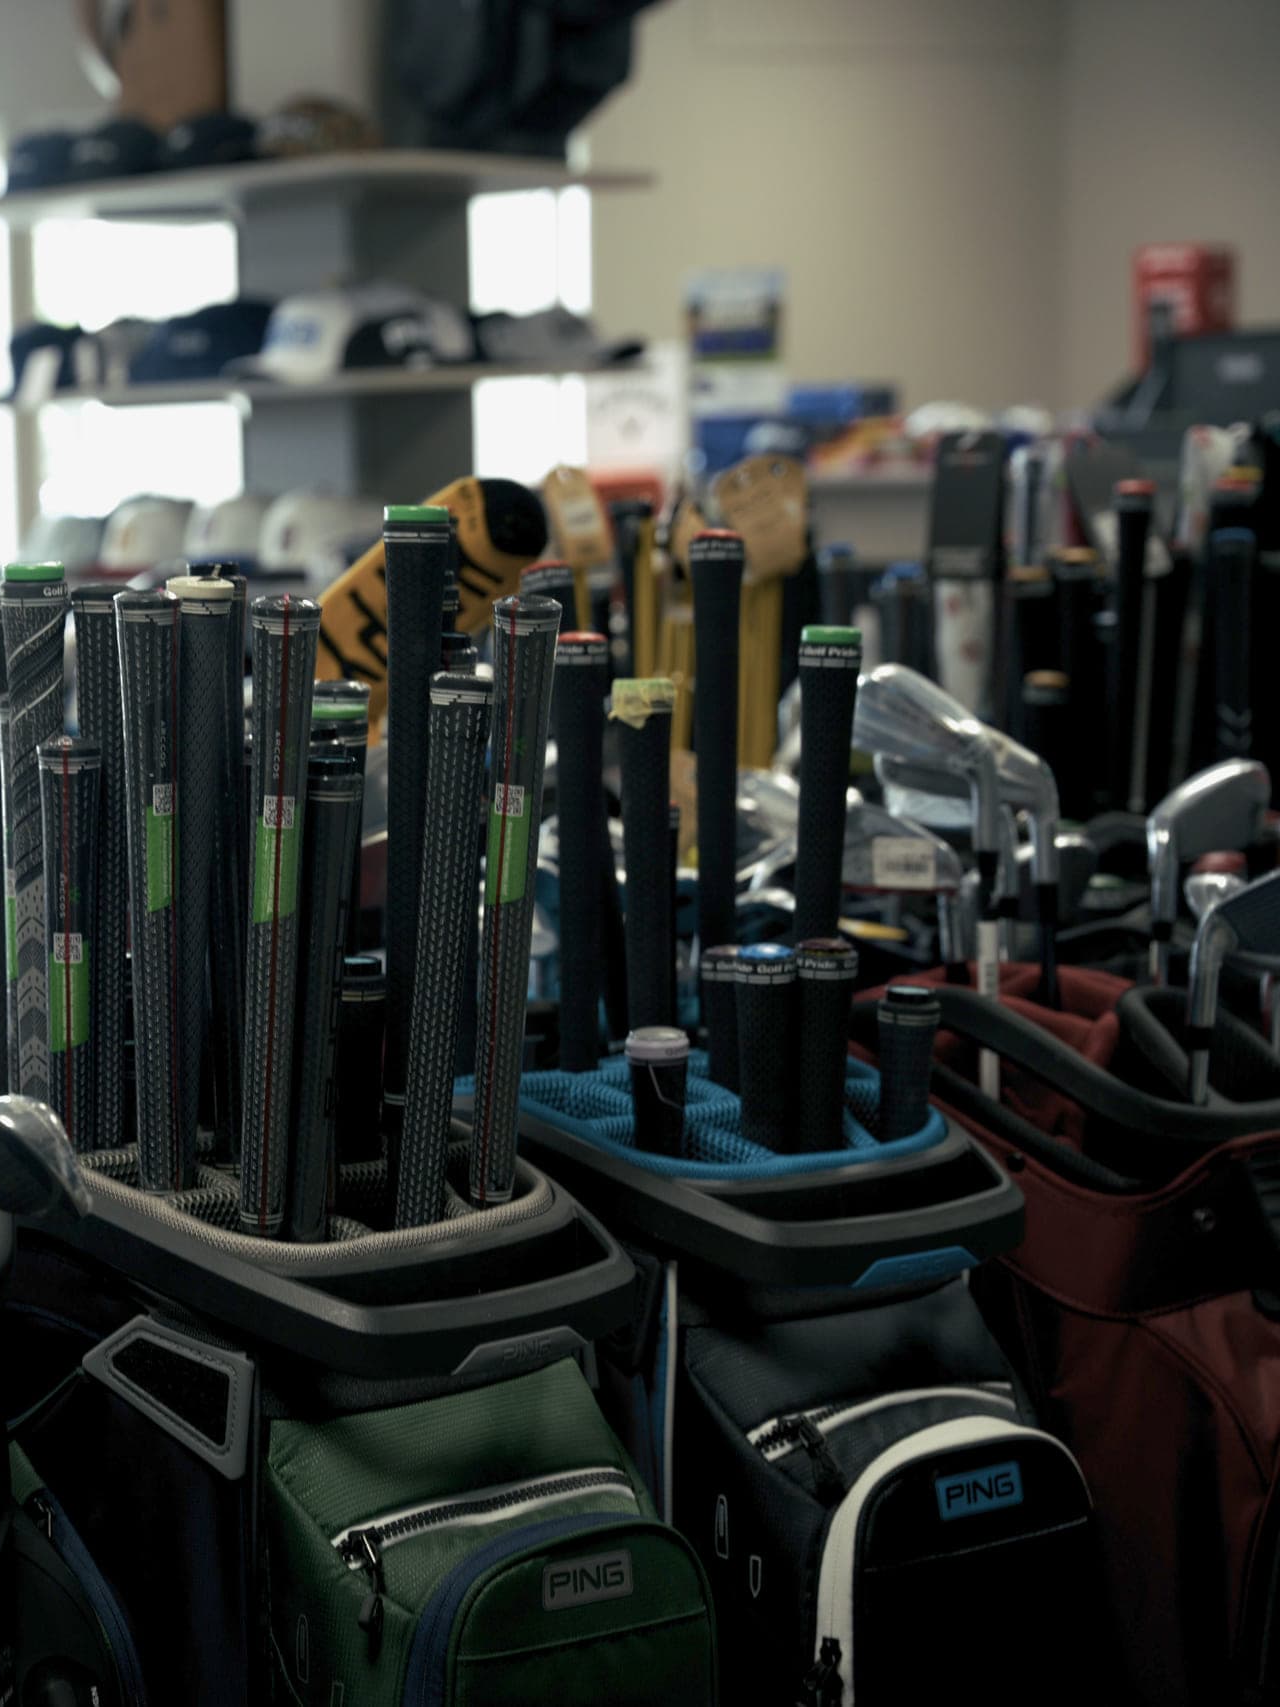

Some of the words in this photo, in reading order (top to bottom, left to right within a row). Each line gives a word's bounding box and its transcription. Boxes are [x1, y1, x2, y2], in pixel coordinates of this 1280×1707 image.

[43, 585, 64, 598] Golf
[757, 963, 783, 975] Golf
[946, 1471, 1015, 1511] PING
[549, 1559, 626, 1599] PING
